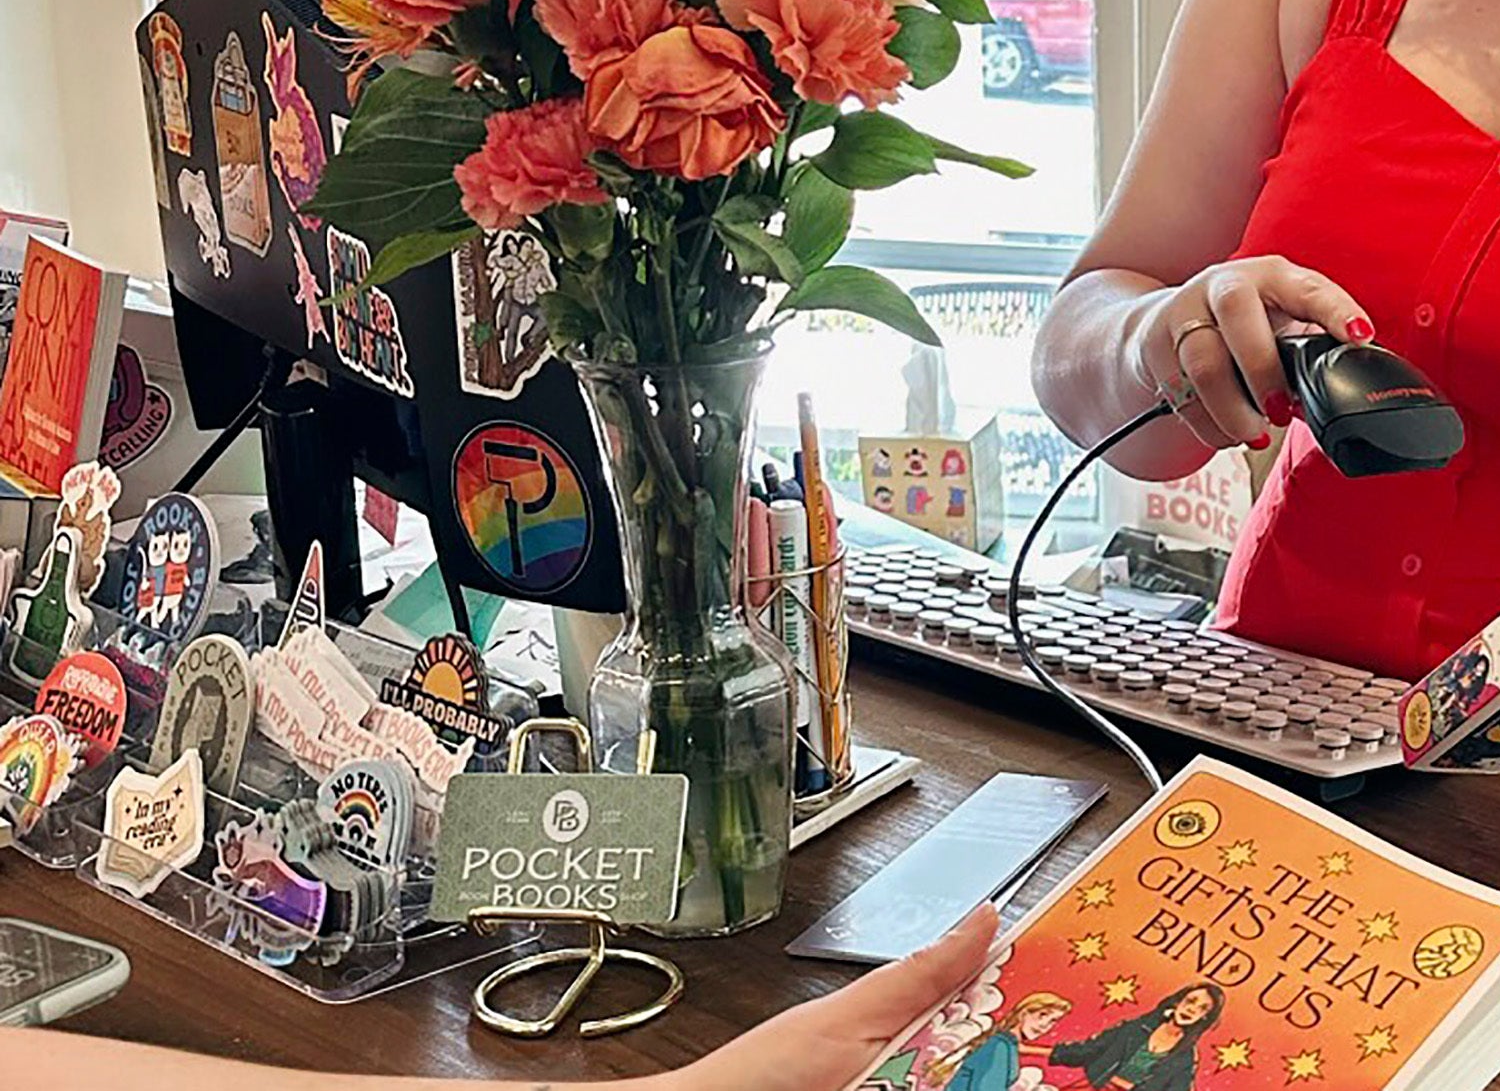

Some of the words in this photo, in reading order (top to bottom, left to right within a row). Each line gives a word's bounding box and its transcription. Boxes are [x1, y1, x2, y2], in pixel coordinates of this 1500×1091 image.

[109, 408, 164, 463] CALLING
[1146, 493, 1239, 543] BOOKS
[176, 642, 247, 700] POCKET
[38, 688, 120, 742] FREEDOM
[383, 682, 411, 710] I'LL
[412, 694, 500, 743] PROBABLY
[330, 773, 354, 800] NO
[125, 814, 179, 841] reading
[460, 846, 656, 881] POCKET
[491, 883, 619, 910] BOOKS
[1266, 863, 1355, 932] THE
[1135, 854, 1279, 942] GIFTS
[1280, 921, 1420, 1012] THAT
[1133, 909, 1256, 990] BIND
[1258, 976, 1335, 1031] US
